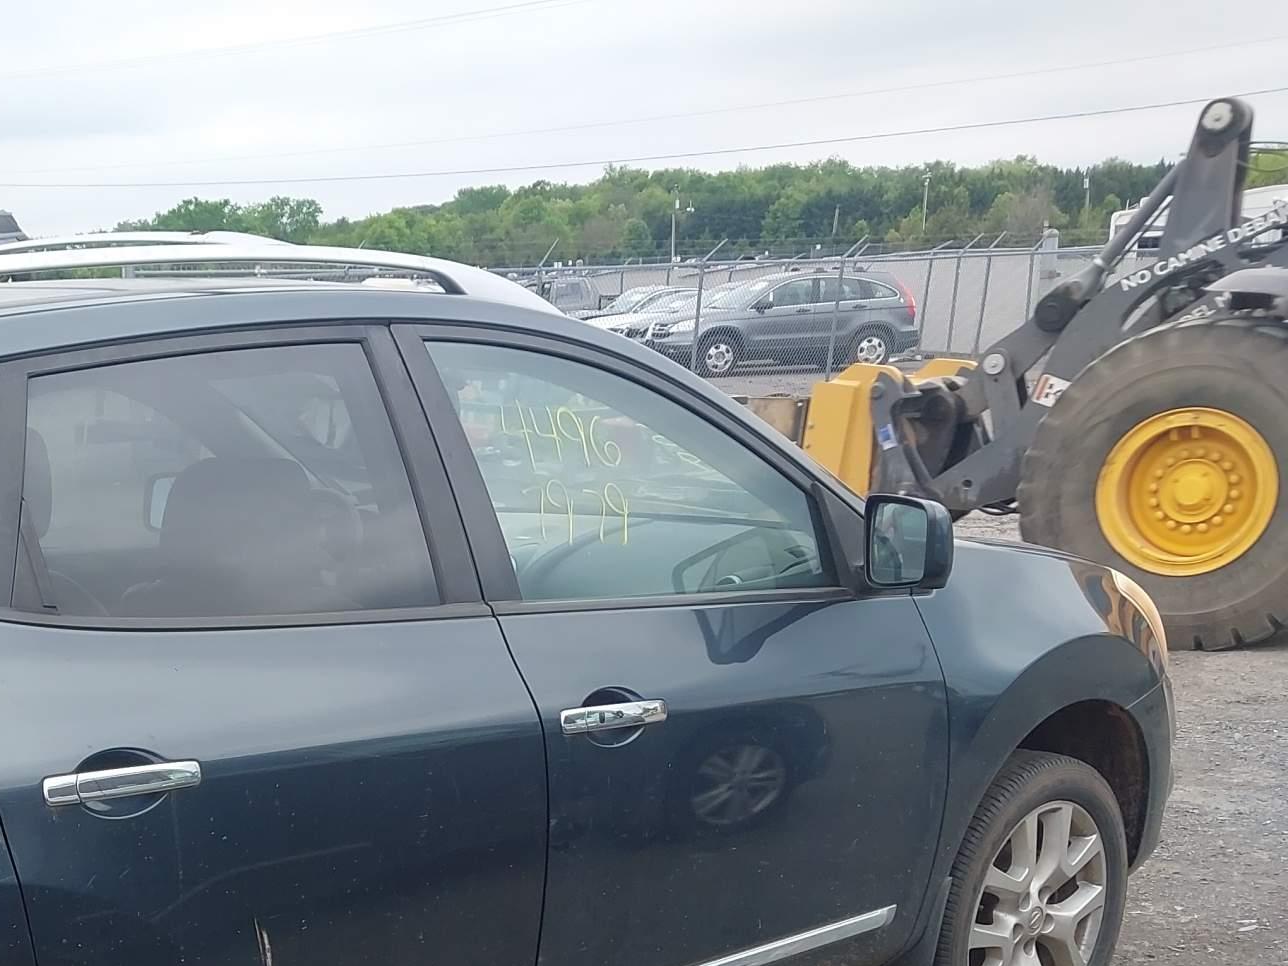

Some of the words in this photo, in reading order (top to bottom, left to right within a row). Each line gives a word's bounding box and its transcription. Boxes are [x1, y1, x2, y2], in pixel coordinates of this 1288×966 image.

[1120, 269, 1152, 291] NO
[1153, 234, 1227, 275] CAMINE
[500, 399, 622, 473] 4496
[521, 479, 630, 545] 7979
